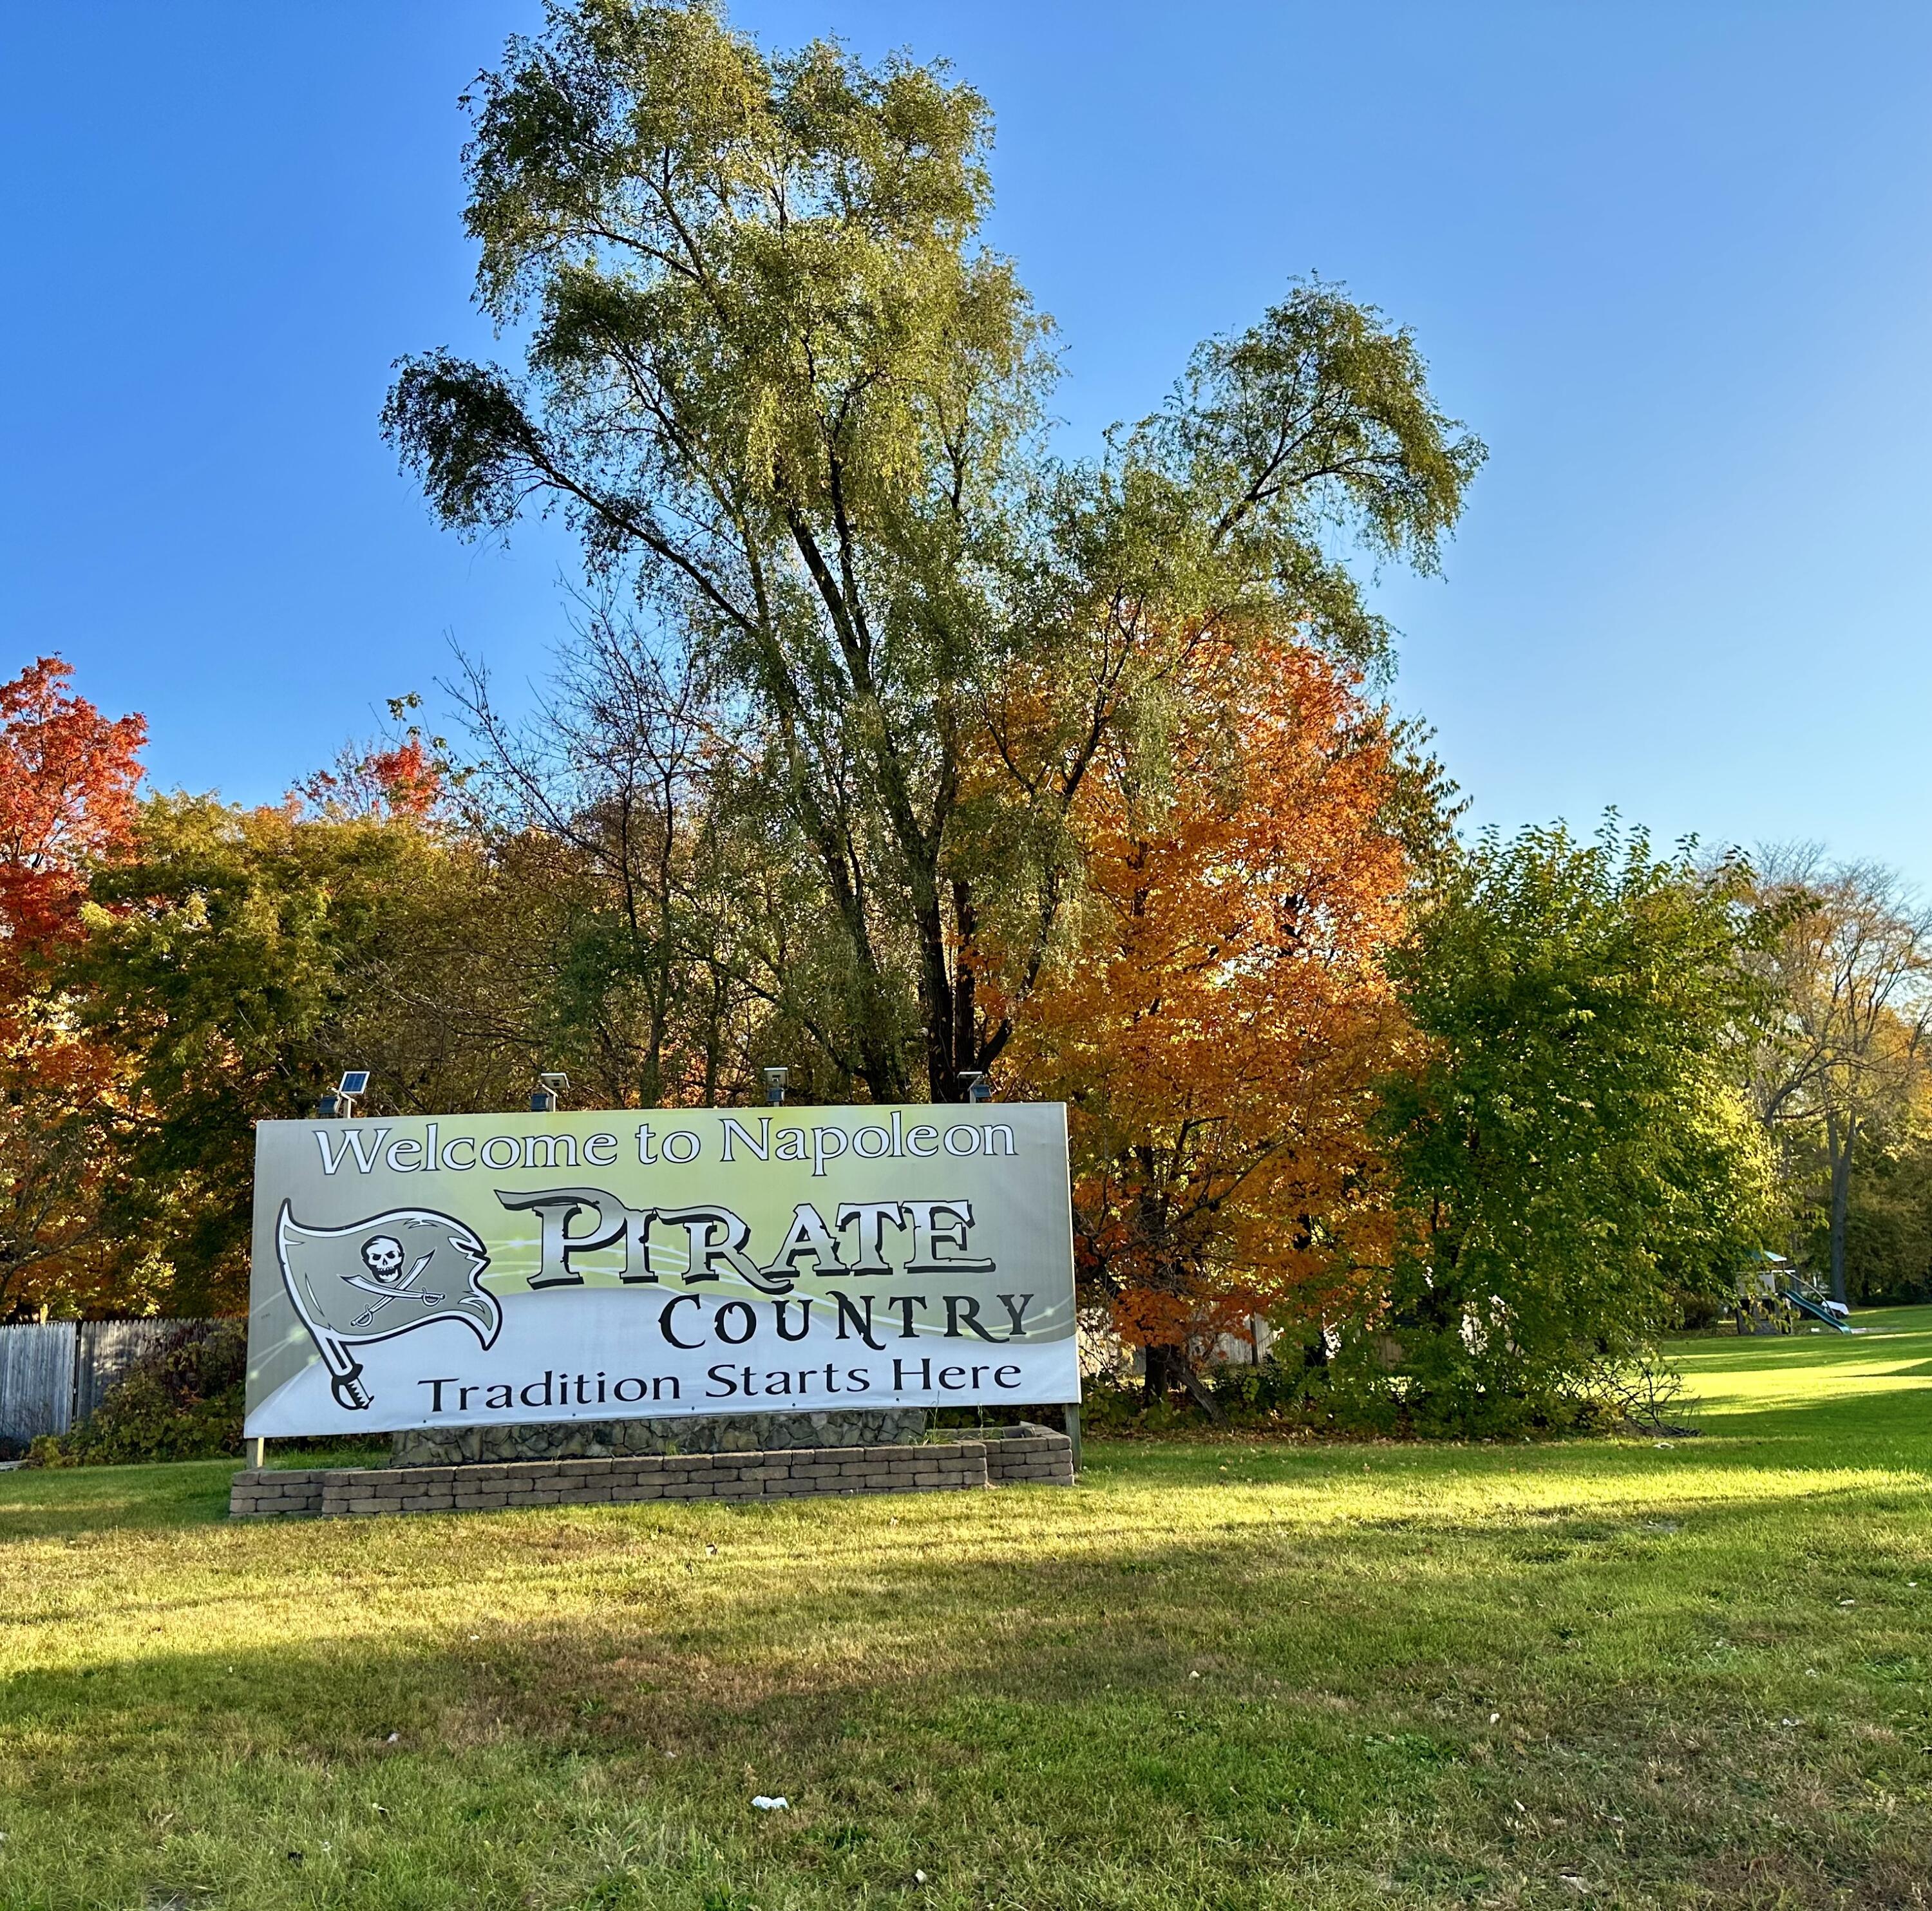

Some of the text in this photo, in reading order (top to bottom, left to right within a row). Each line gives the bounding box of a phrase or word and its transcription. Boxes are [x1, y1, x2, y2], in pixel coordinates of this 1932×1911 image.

[312, 1111, 1018, 1176] Welcome to Napoleon
[493, 1187, 996, 1295] PIRATE
[658, 1290, 1035, 1350] COUNTRY
[417, 1358, 1022, 1413] Tradition Starts Here
